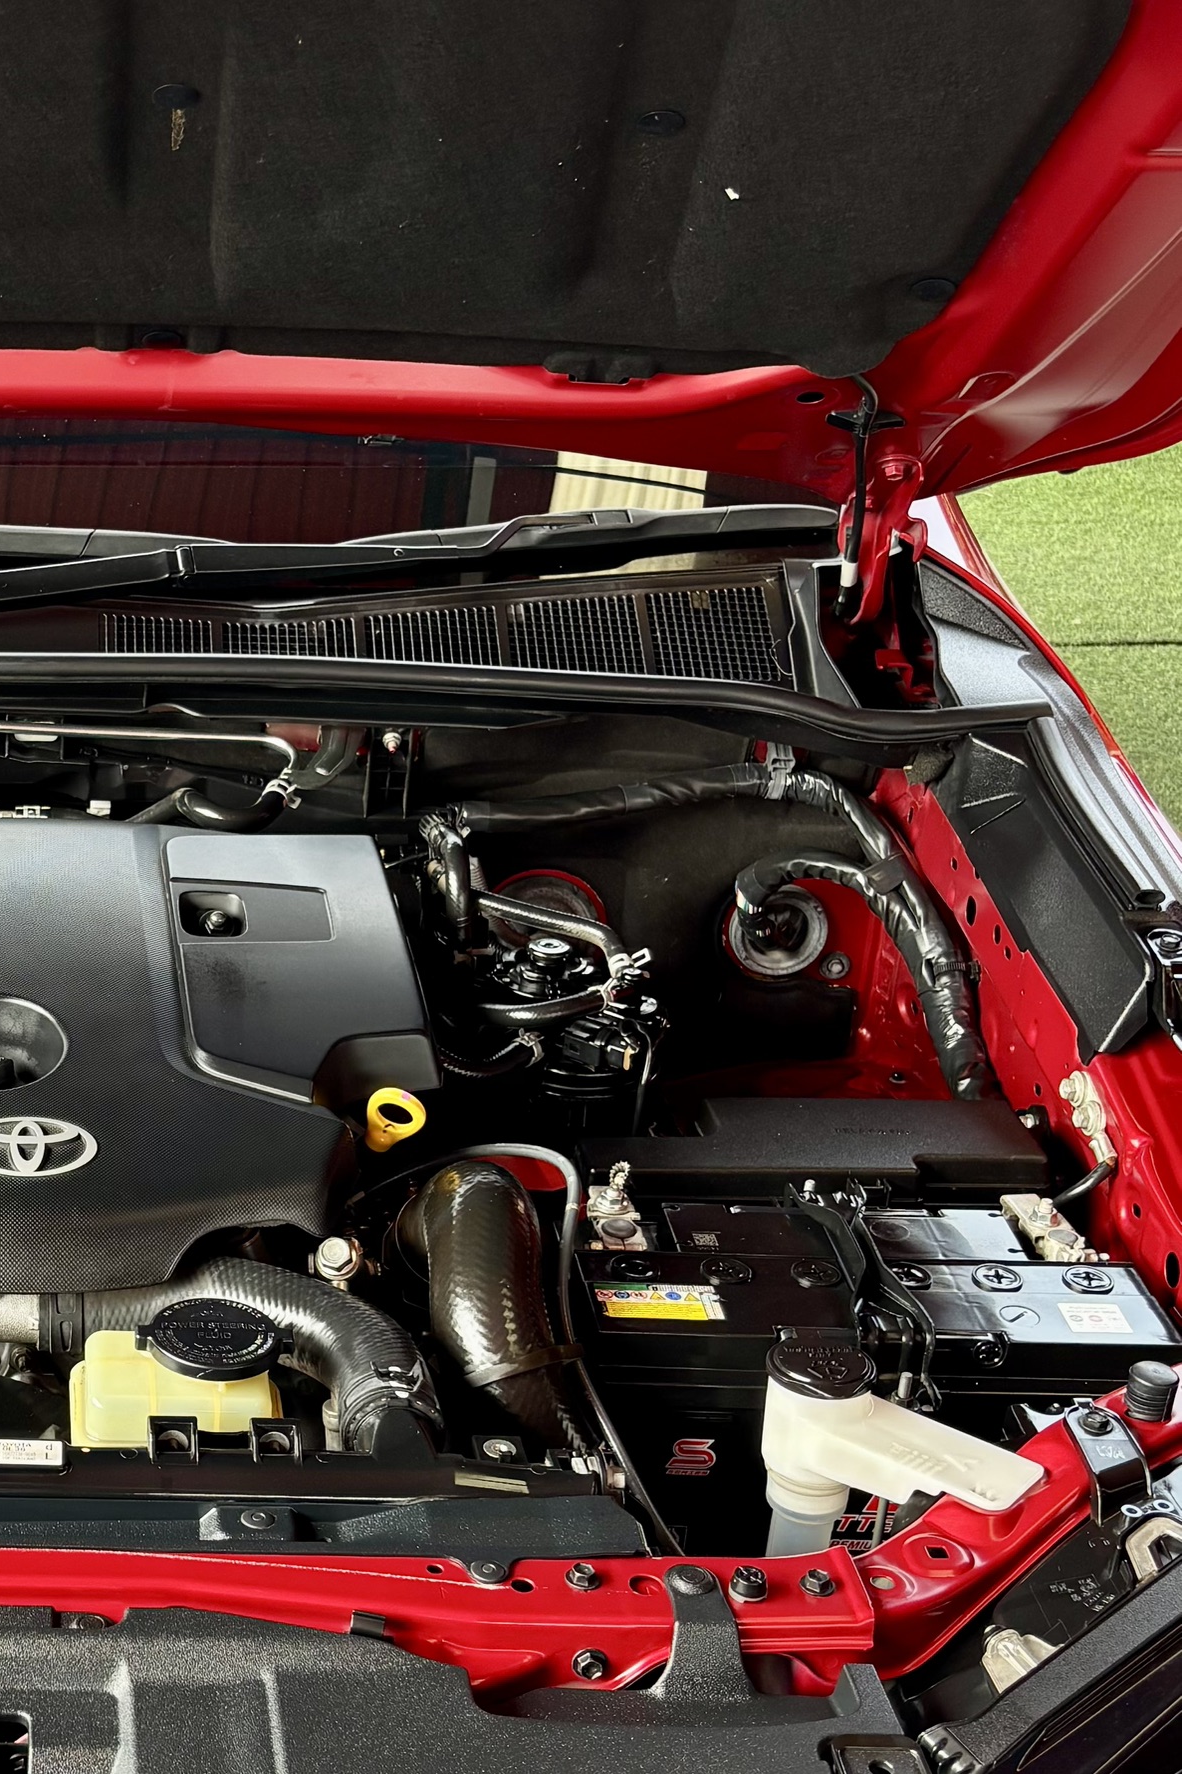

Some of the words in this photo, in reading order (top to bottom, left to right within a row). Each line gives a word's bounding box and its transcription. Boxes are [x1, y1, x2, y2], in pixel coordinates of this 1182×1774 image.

[160, 1321, 205, 1331] POWER
[207, 1321, 267, 1332] STEERING
[197, 1330, 232, 1340] FLUID
